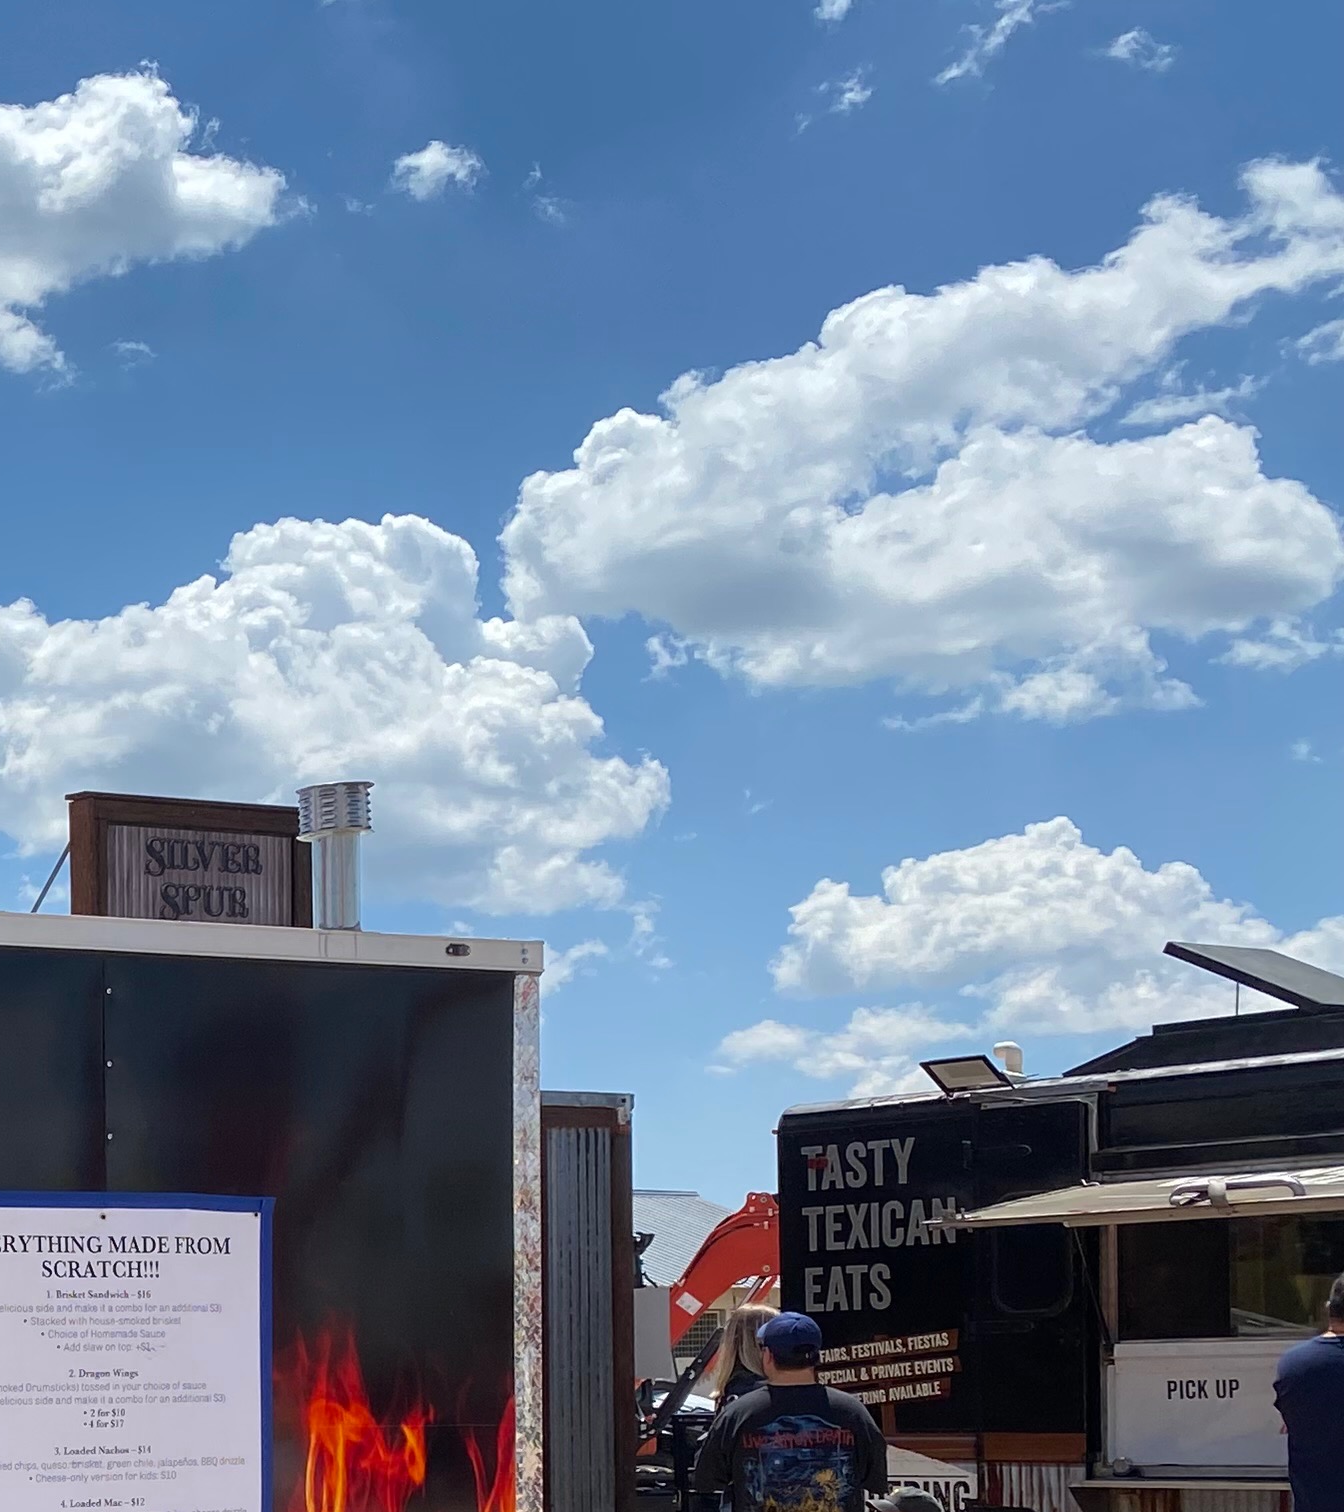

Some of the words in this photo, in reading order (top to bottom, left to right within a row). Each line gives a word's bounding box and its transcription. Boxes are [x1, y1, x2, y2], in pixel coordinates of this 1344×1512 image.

[145, 836, 263, 877] SILVER
[160, 882, 249, 920] SPUR
[801, 1137, 916, 1191] TASTY
[802, 1197, 957, 1252] TEXICAN
[108, 1236, 169, 1253] MADE
[175, 1237, 230, 1254] FROM
[42, 1260, 159, 1278] SCRATCH!!!
[56, 1290, 85, 1298] Brisket
[88, 1290, 129, 1298] Sandwich
[138, 1290, 151, 1299] $16
[804, 1263, 892, 1312] EATS
[31, 1317, 66, 1326] Stacked
[69, 1317, 87, 1325] with
[89, 1317, 150, 1325] house-smoked
[152, 1317, 181, 1325] brisket
[48, 1330, 78, 1338] Choice
[80, 1329, 88, 1339] of
[91, 1330, 138, 1338] Homemade
[140, 1329, 166, 1338] Sauce
[63, 1343, 80, 1352] Add
[83, 1343, 103, 1351] slaw
[819, 1348, 850, 1364] FAIRS,
[852, 1339, 906, 1359] FESTIVALS,
[907, 1332, 949, 1350] FIESTAS
[79, 1369, 110, 1379] Dragon
[113, 1369, 138, 1379] Wings
[817, 1367, 857, 1385] SPECIAL
[860, 1368, 869, 1381] &
[872, 1362, 912, 1380] PRIVATE
[914, 1358, 954, 1375] EVENTS
[26, 1383, 79, 1392] Drumsticks)
[81, 1383, 110, 1391] tossed
[122, 1384, 141, 1392] your
[172, 1382, 180, 1390] of
[889, 1381, 941, 1401] AVAILABLE
[1167, 1380, 1208, 1400] PICK
[1215, 1379, 1240, 1399] UP
[98, 1409, 110, 1417] for
[112, 1409, 125, 1417] $10
[111, 1419, 124, 1428] $17
[64, 1447, 96, 1455] Loaded
[138, 1446, 151, 1454] $14
[36, 1473, 88, 1483] Cheese-only
[125, 1472, 138, 1480] for
[160, 1471, 176, 1479] $10
[70, 1499, 101, 1507] Loaded
[131, 1498, 145, 1506] $12
